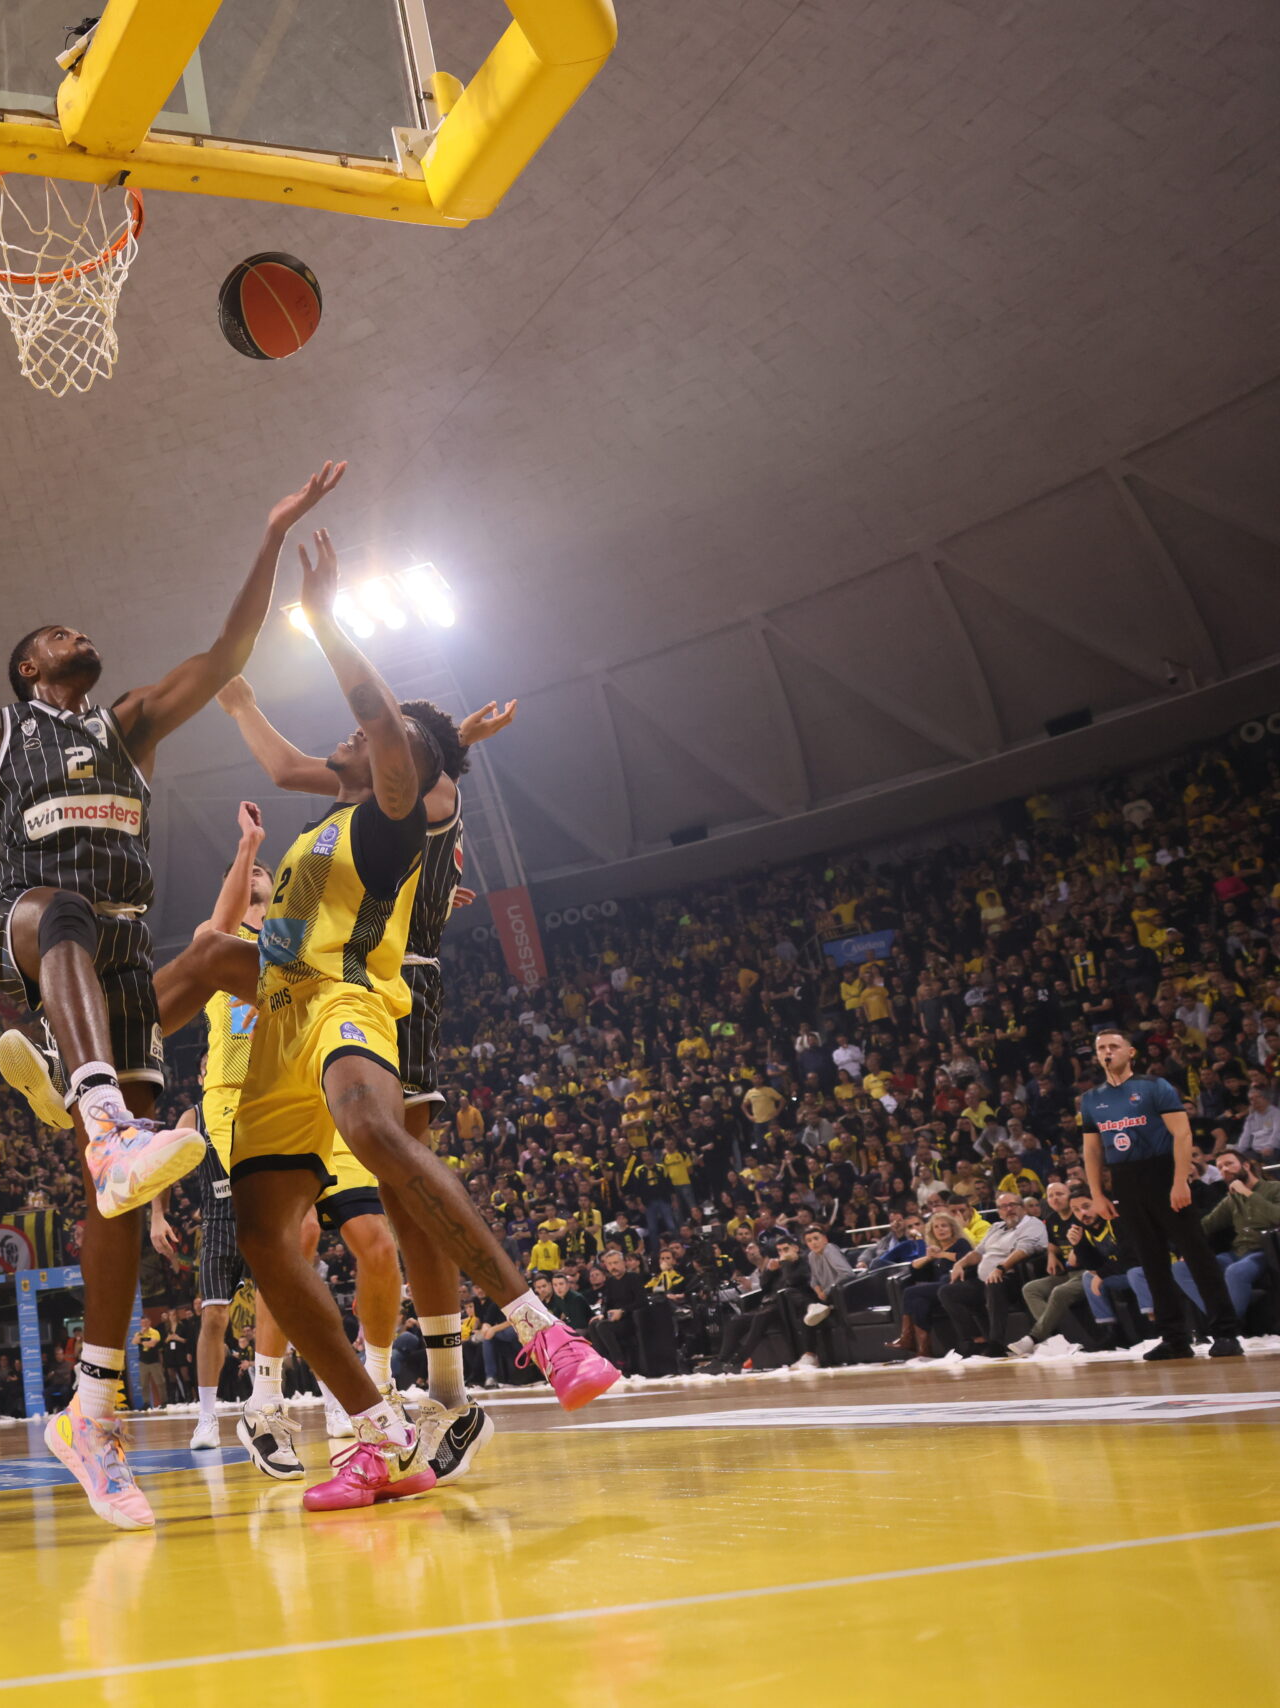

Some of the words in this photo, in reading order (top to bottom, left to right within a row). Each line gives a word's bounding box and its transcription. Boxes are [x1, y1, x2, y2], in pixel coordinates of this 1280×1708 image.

[64, 746, 95, 780] 2
[26, 801, 141, 832] winmasters
[272, 866, 292, 904] 2
[506, 904, 540, 986] etsson
[269, 987, 293, 1013] ARIS
[442, 1334, 461, 1347] GS
[80, 1363, 101, 1377] SA
